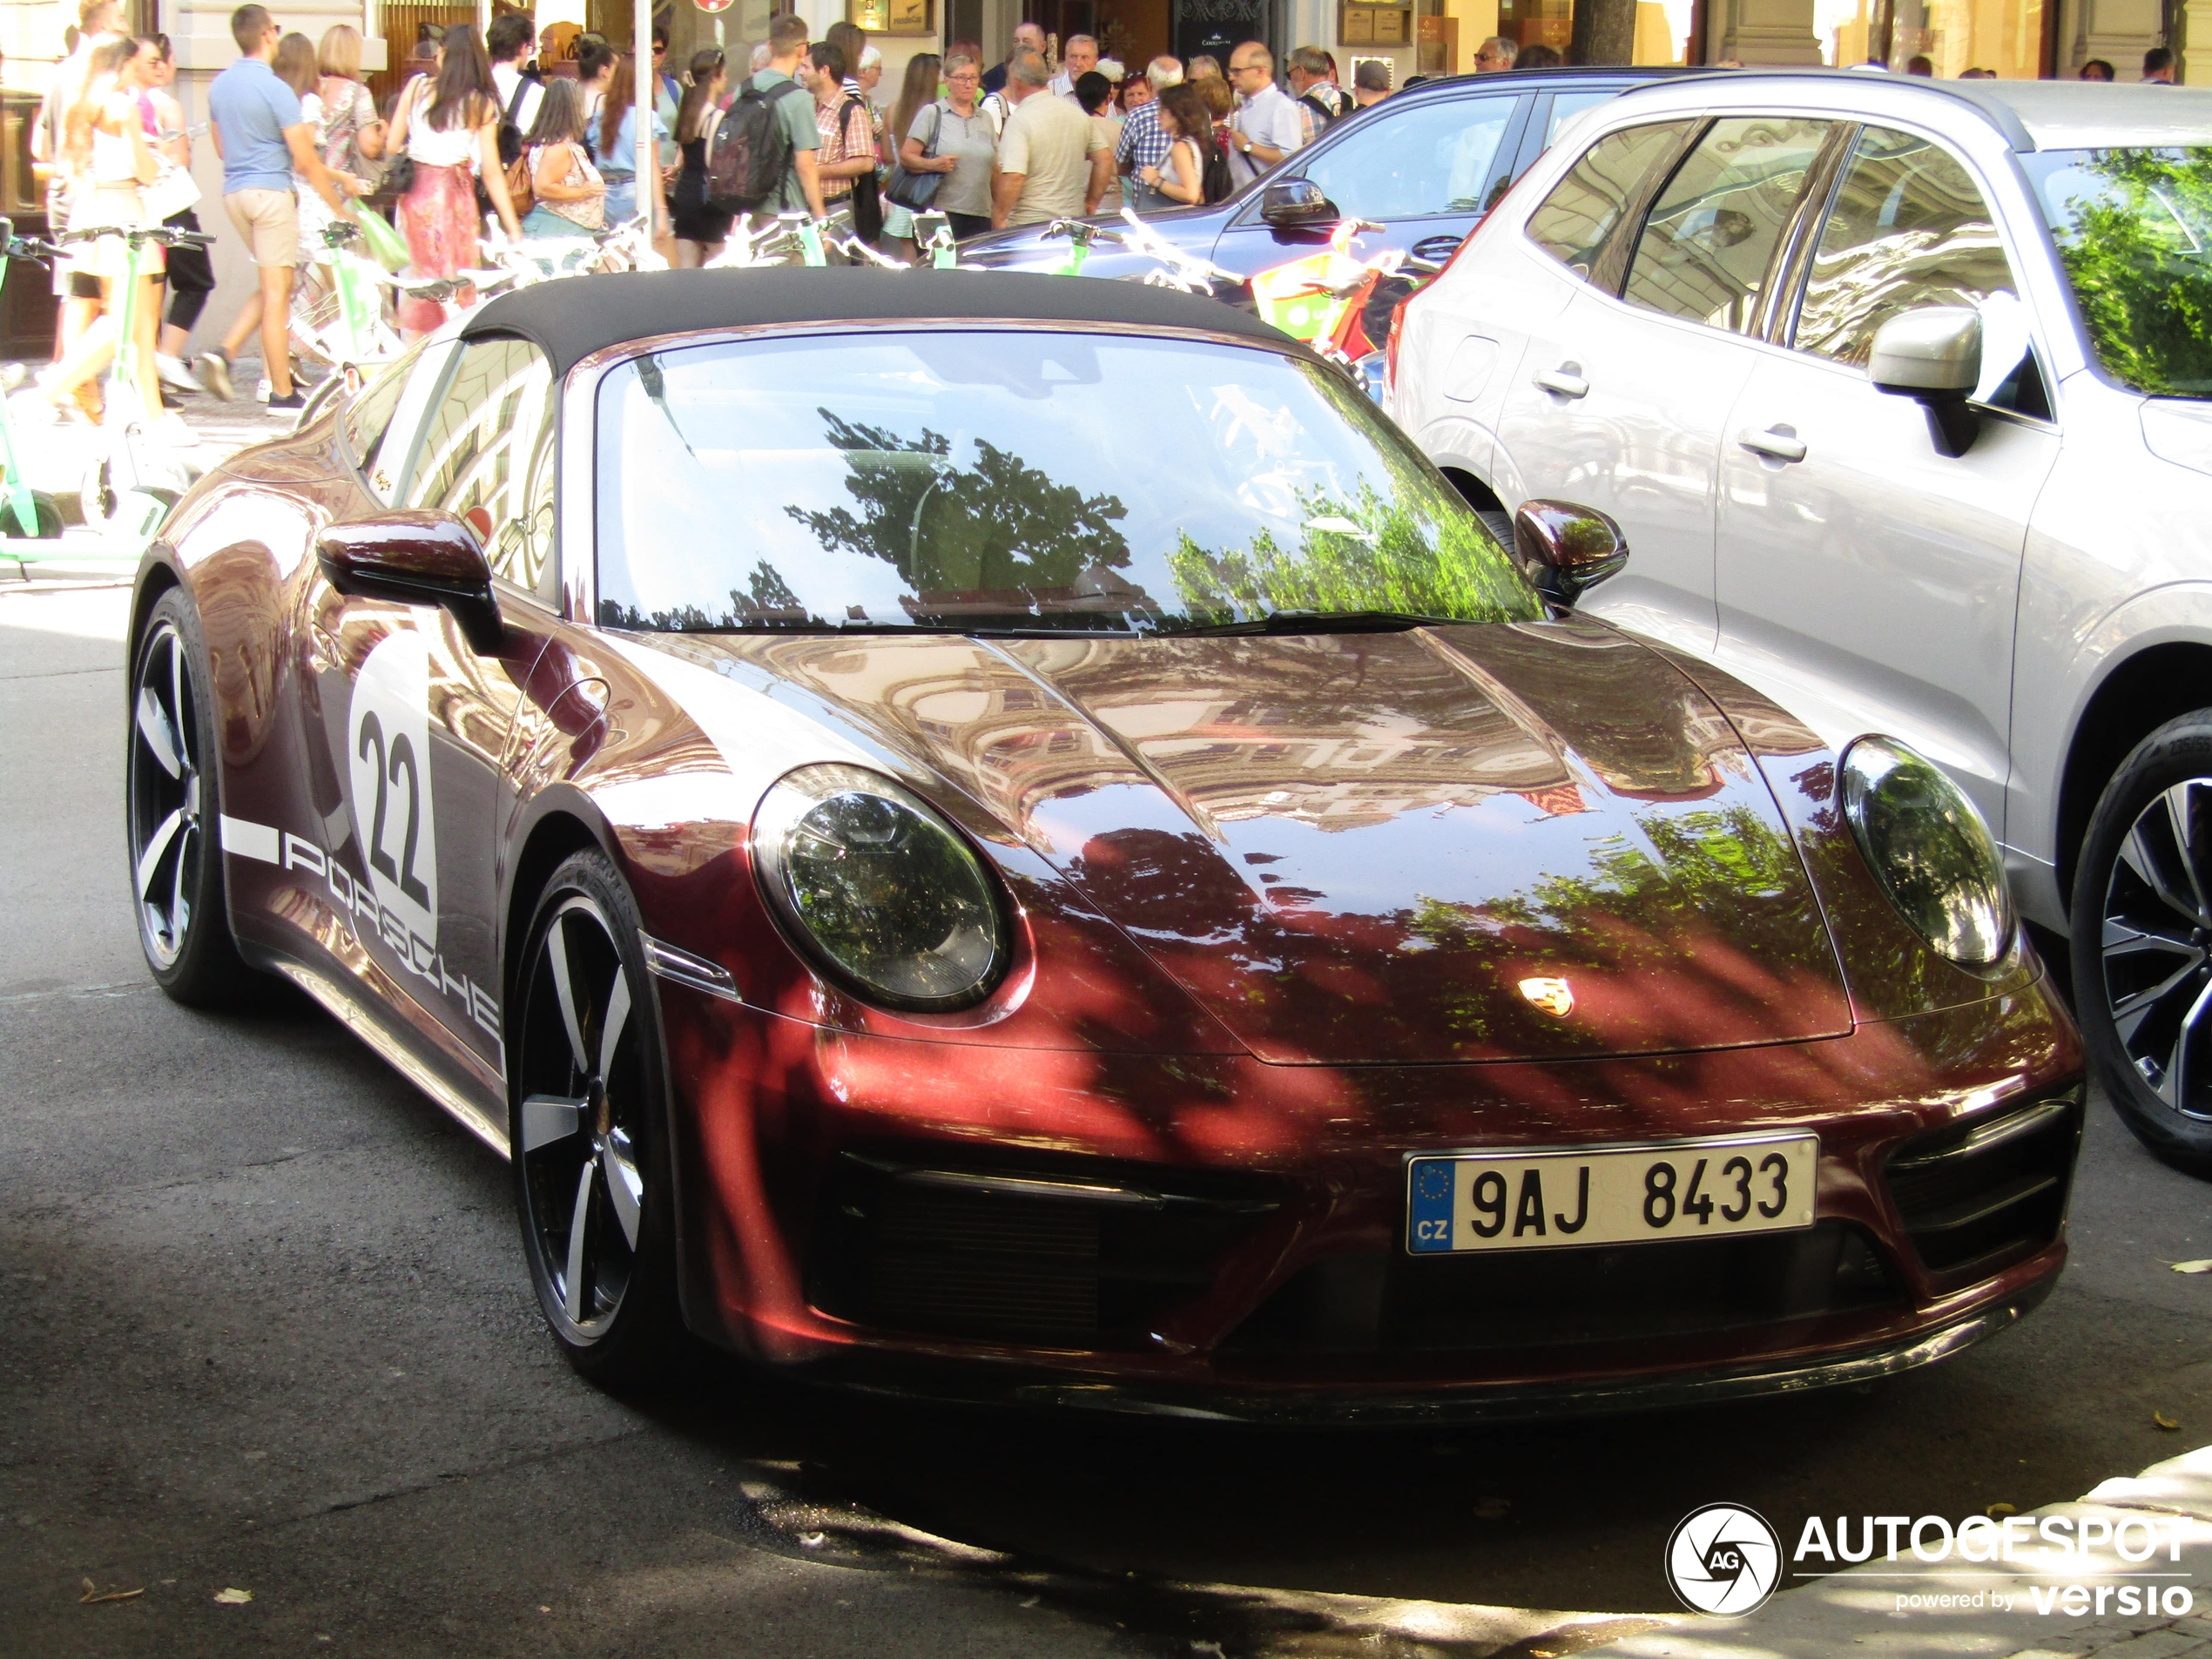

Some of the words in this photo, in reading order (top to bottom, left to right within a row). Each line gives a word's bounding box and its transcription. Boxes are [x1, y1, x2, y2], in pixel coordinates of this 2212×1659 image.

[359, 709, 430, 902] 22
[284, 831, 502, 1038] PORSCHE
[1418, 1220, 1447, 1240] CZ
[1472, 1165, 1590, 1238] 9AJ
[1642, 1151, 1789, 1229] 8433
